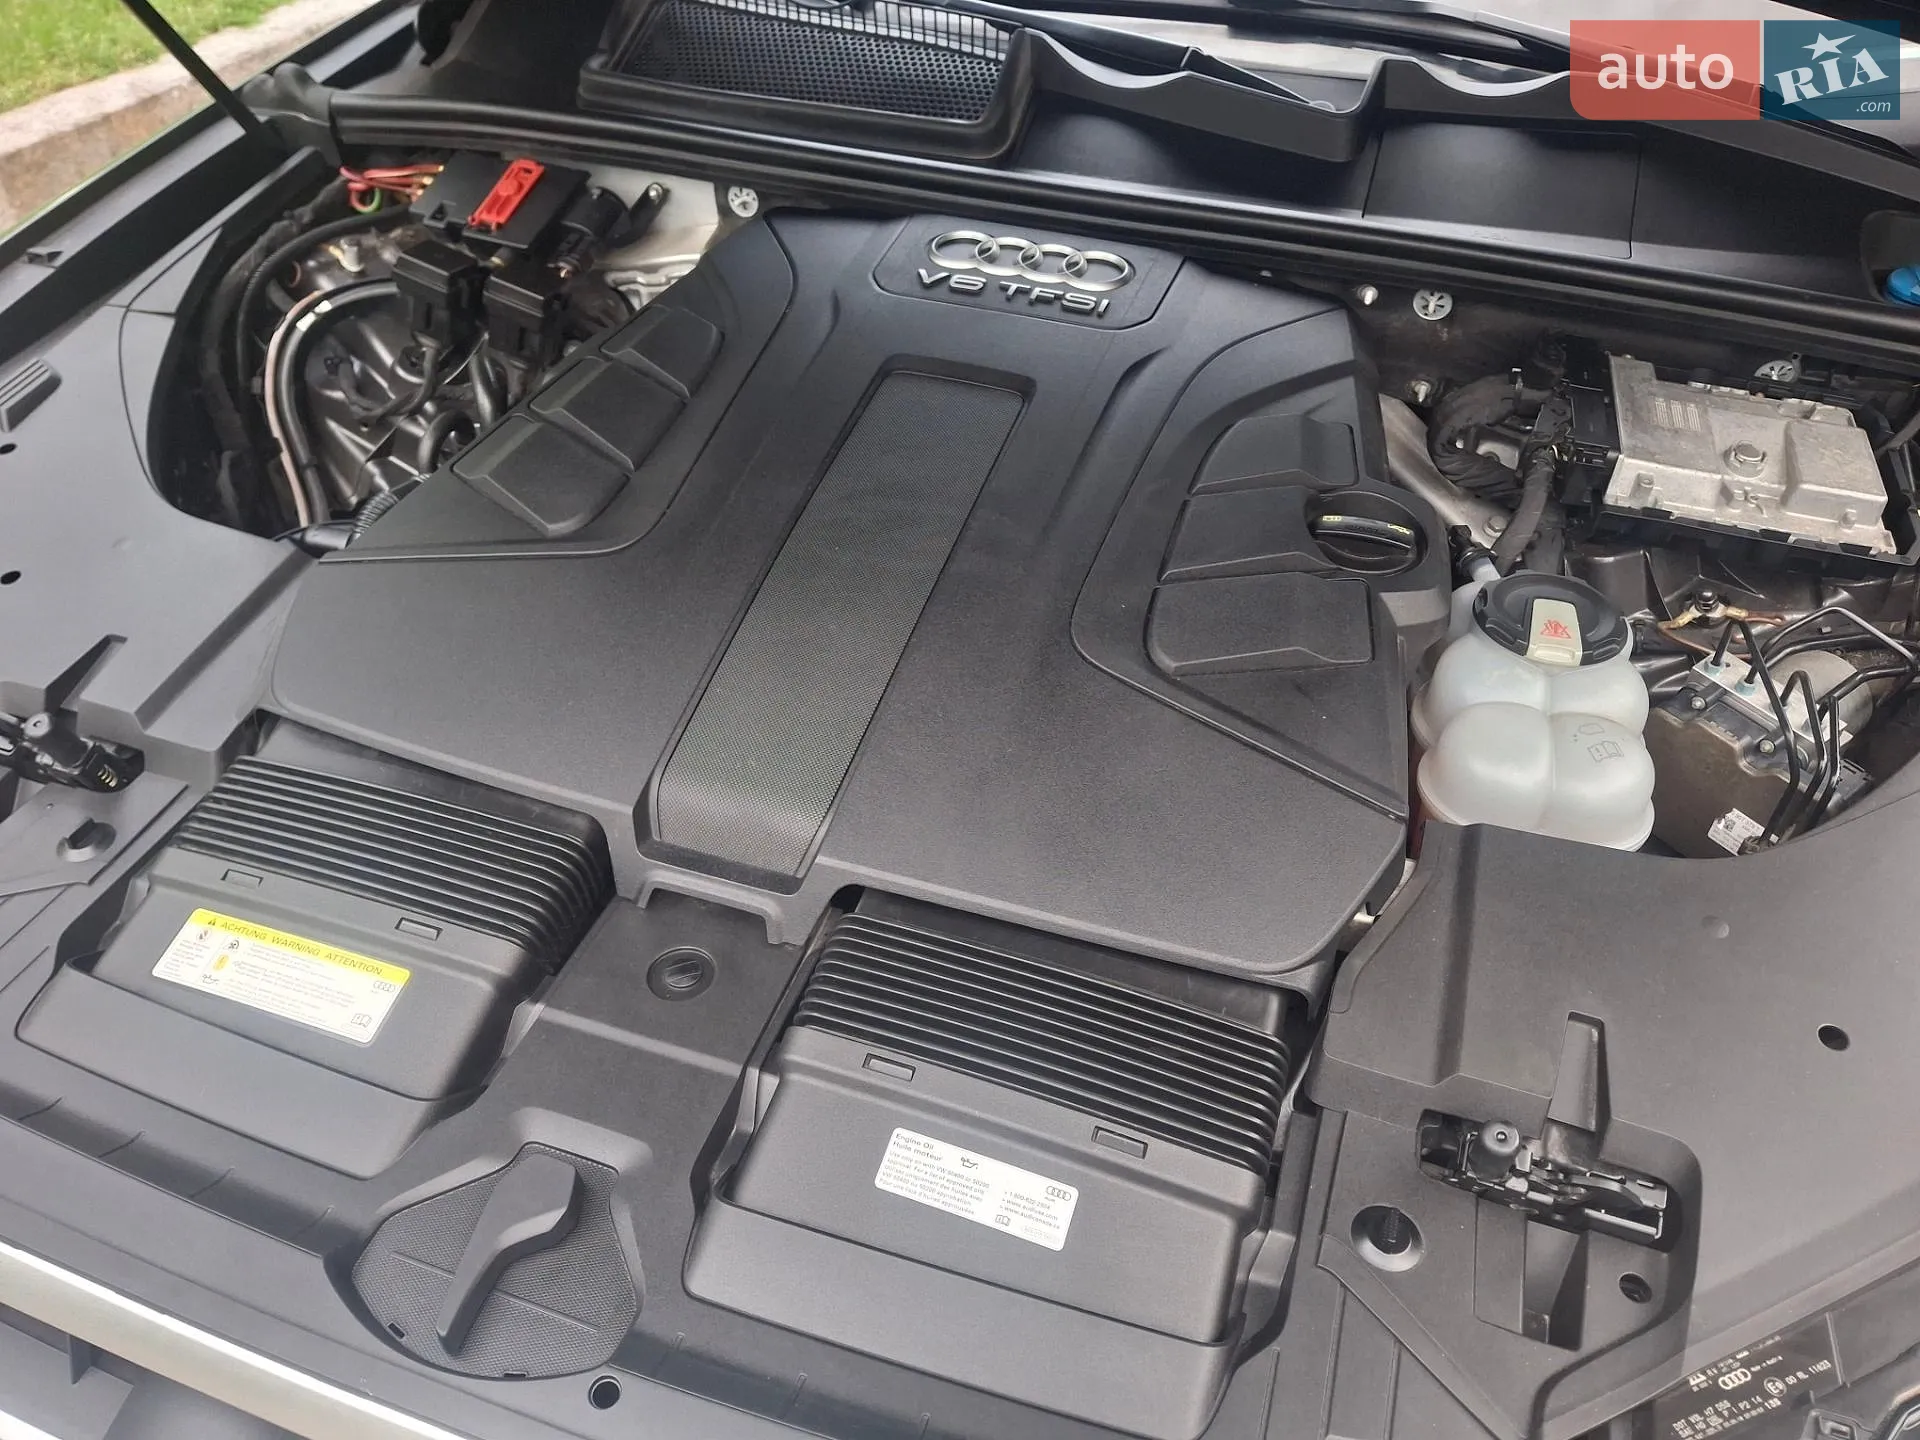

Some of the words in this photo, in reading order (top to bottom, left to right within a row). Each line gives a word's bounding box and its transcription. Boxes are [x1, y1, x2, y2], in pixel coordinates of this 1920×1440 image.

[918, 268, 987, 293] V6
[999, 279, 1110, 317] TFSI
[220, 920, 267, 940] ACHTUNG
[271, 936, 321, 956] WARNING
[325, 952, 383, 975] ATTENTION
[895, 1133, 921, 1145] Engine
[913, 1148, 942, 1161] moteur
